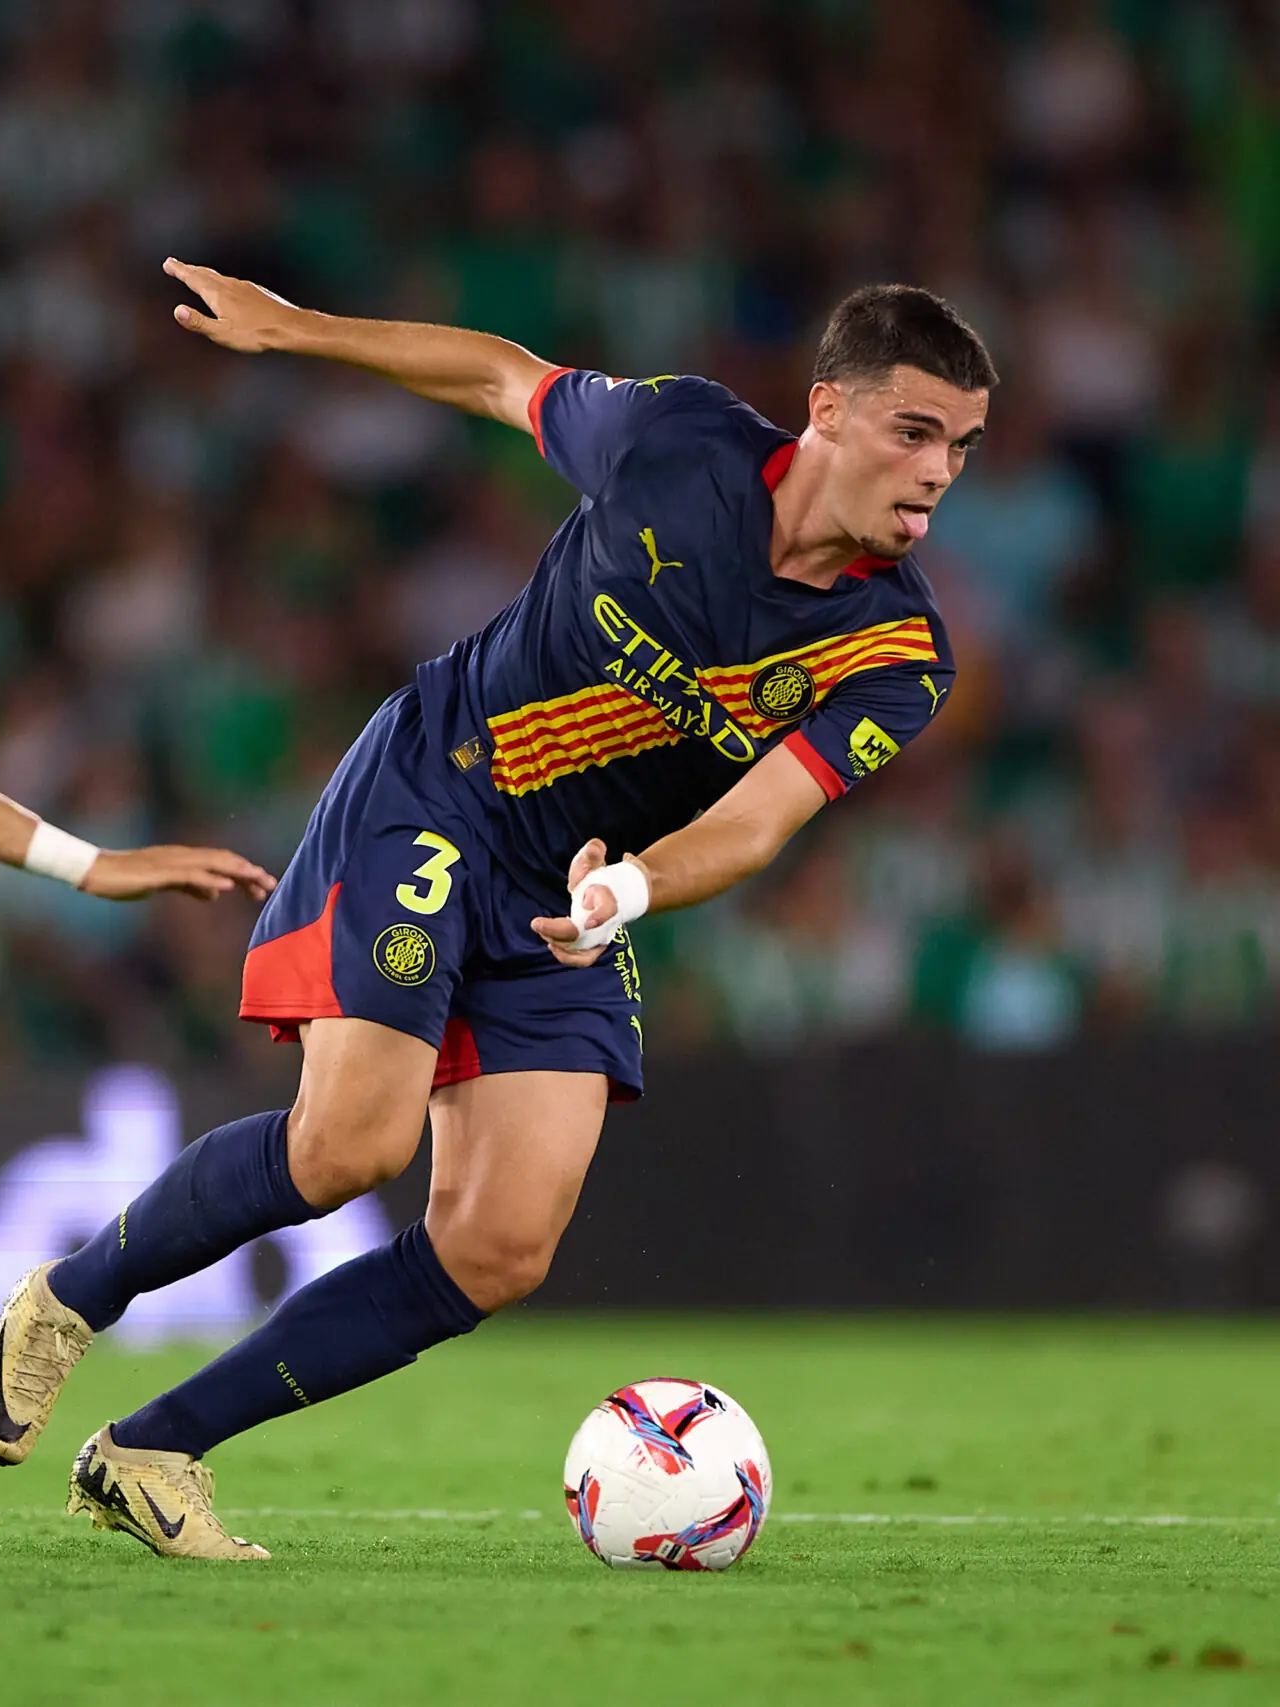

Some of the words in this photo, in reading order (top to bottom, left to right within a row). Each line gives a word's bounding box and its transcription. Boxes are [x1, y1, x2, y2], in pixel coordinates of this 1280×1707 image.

[593, 593, 755, 763] ETIHAD
[605, 658, 710, 737] AIRWAYS
[775, 665, 810, 690] GIRONA
[396, 830, 462, 915] 3
[391, 927, 429, 949] GIRONA
[382, 962, 403, 980] FUTBOL
